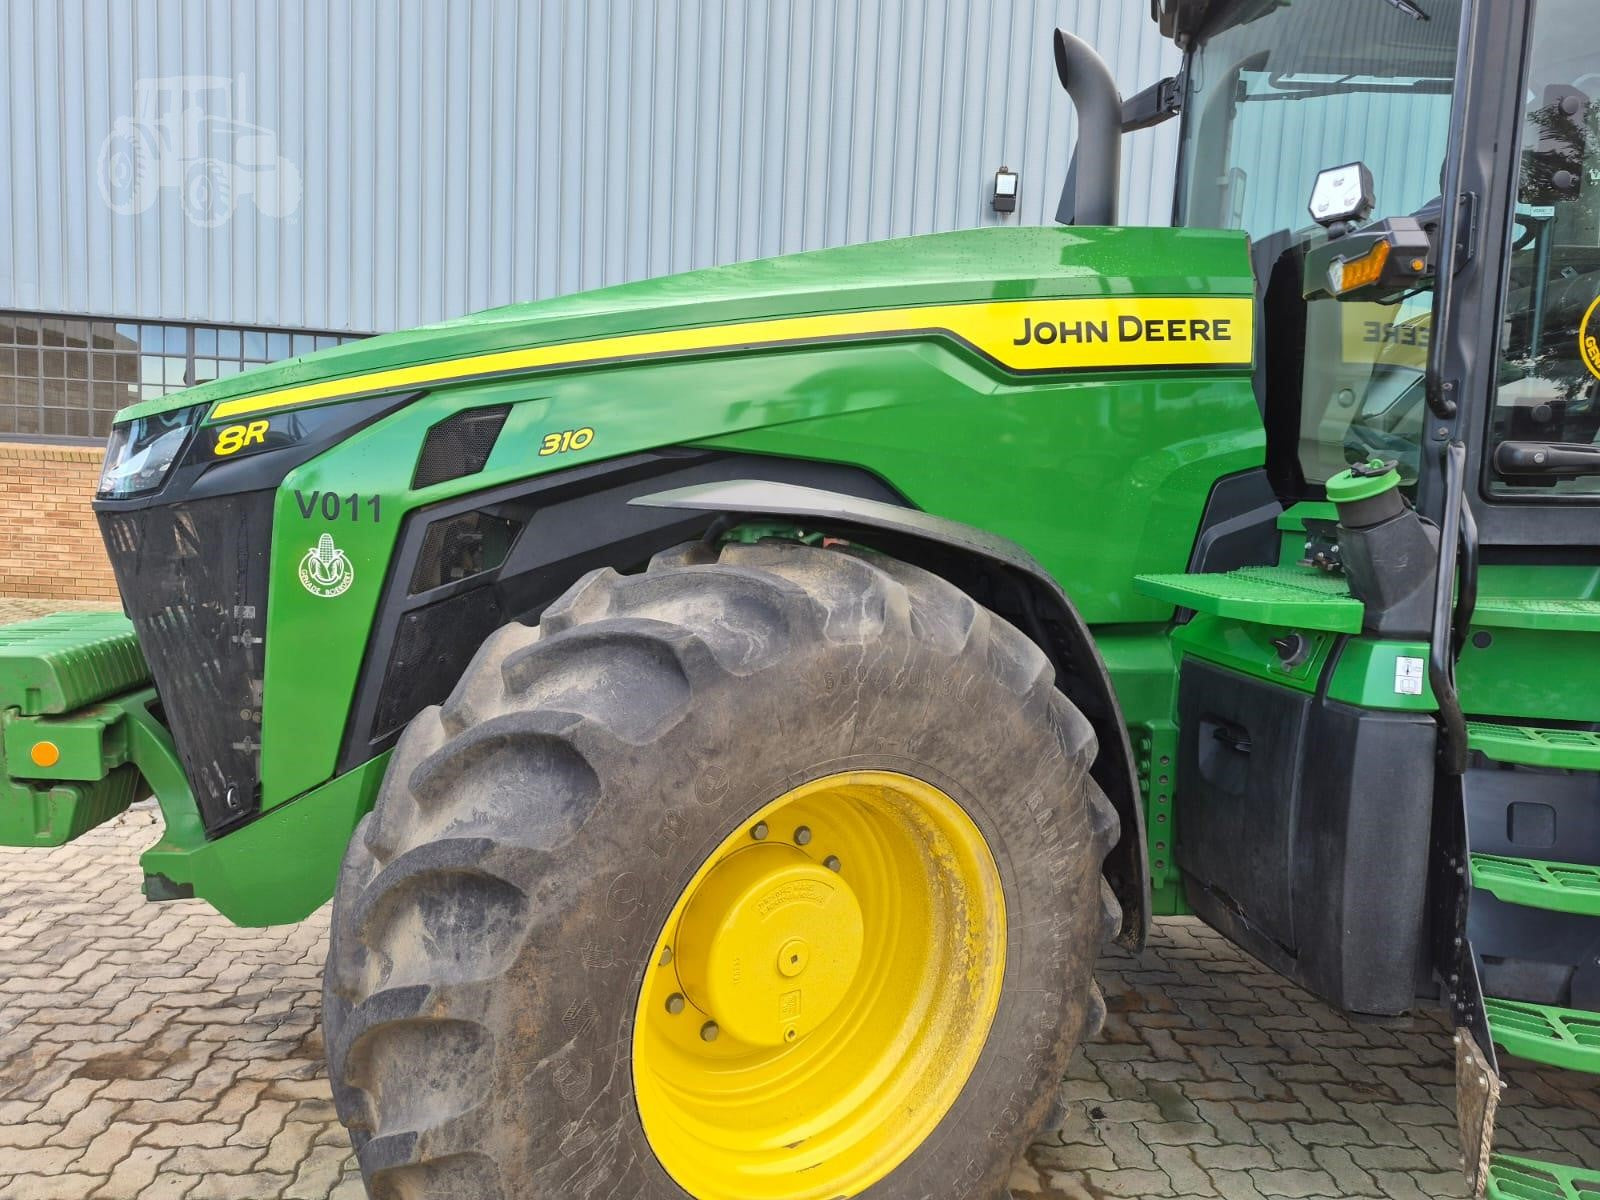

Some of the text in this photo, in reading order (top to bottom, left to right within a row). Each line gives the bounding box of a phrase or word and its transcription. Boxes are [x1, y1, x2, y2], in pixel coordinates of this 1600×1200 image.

[1013, 315, 1232, 346] JOHN DEERE
[213, 419, 270, 457] 8R
[539, 426, 595, 456] 310
[295, 490, 381, 523] V011
